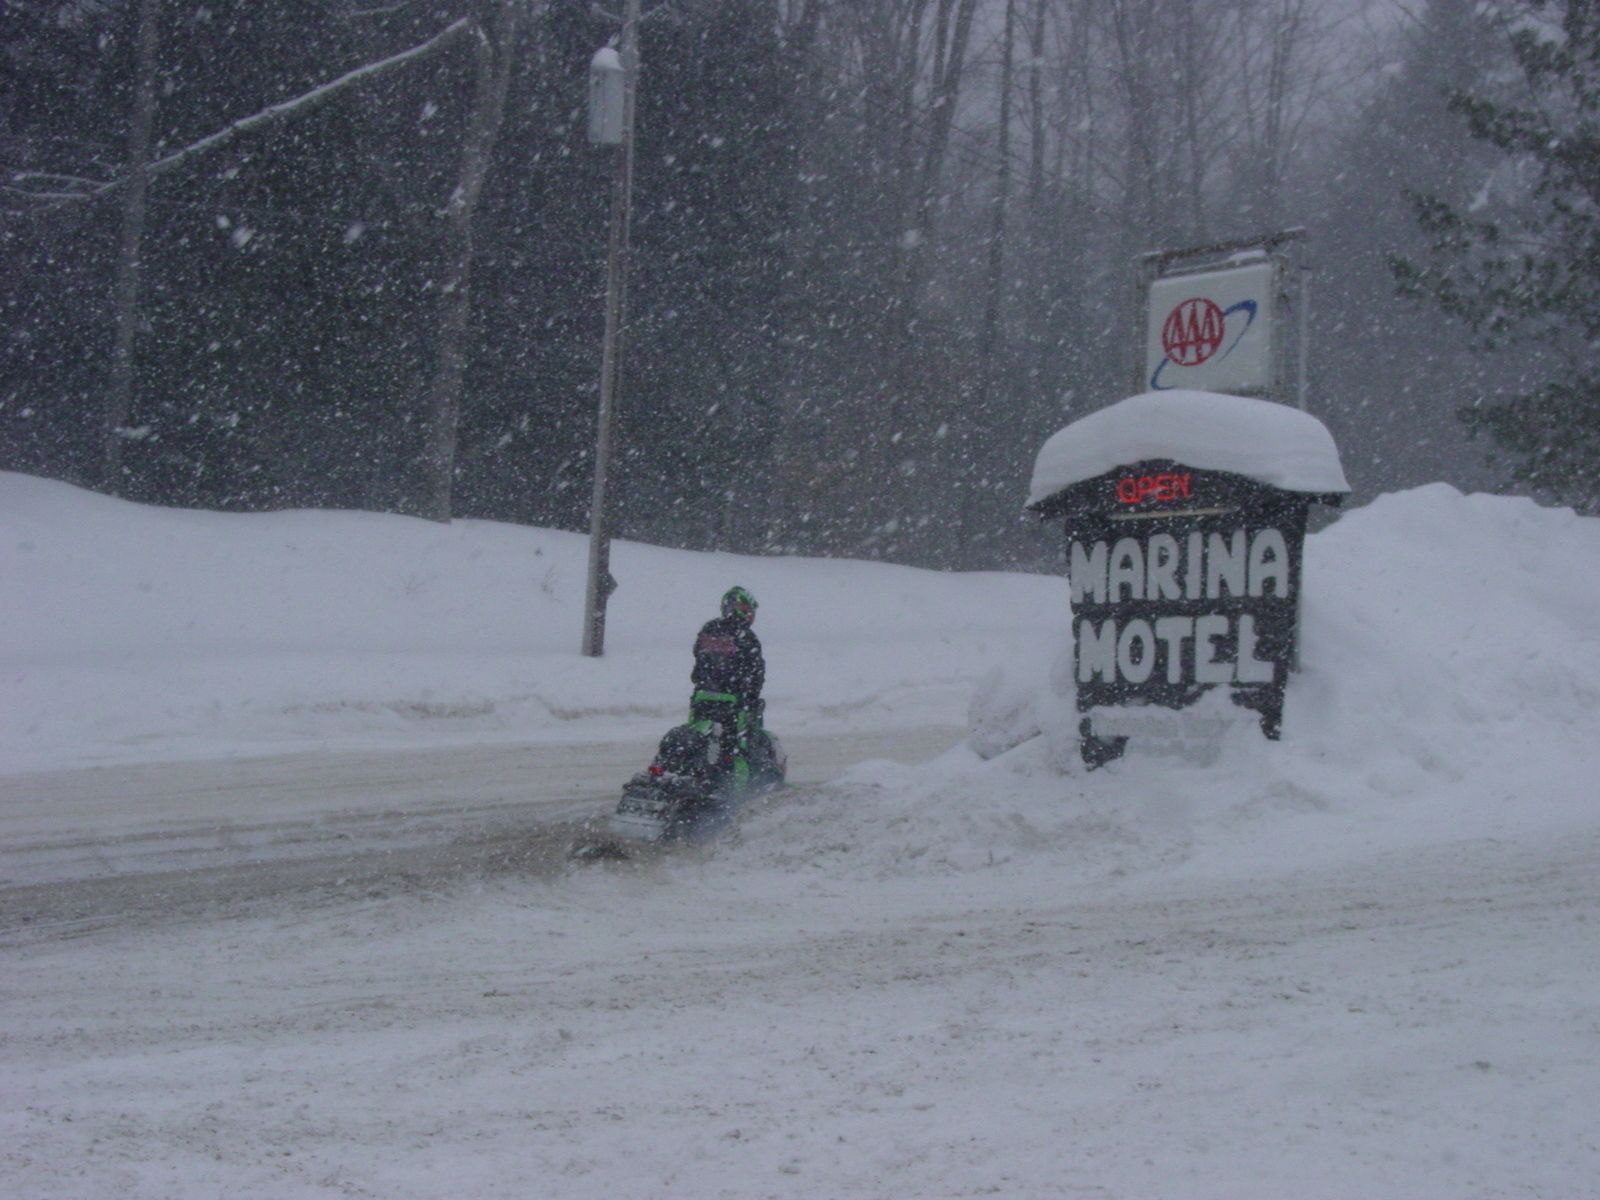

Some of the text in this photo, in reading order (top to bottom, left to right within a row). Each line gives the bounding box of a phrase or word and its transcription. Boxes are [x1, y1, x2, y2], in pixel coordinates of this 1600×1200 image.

[1164, 300, 1223, 365] AAA
[1117, 473, 1192, 504] OPEN
[1070, 528, 1290, 604] MARINA
[1078, 614, 1275, 685] MOTEL
